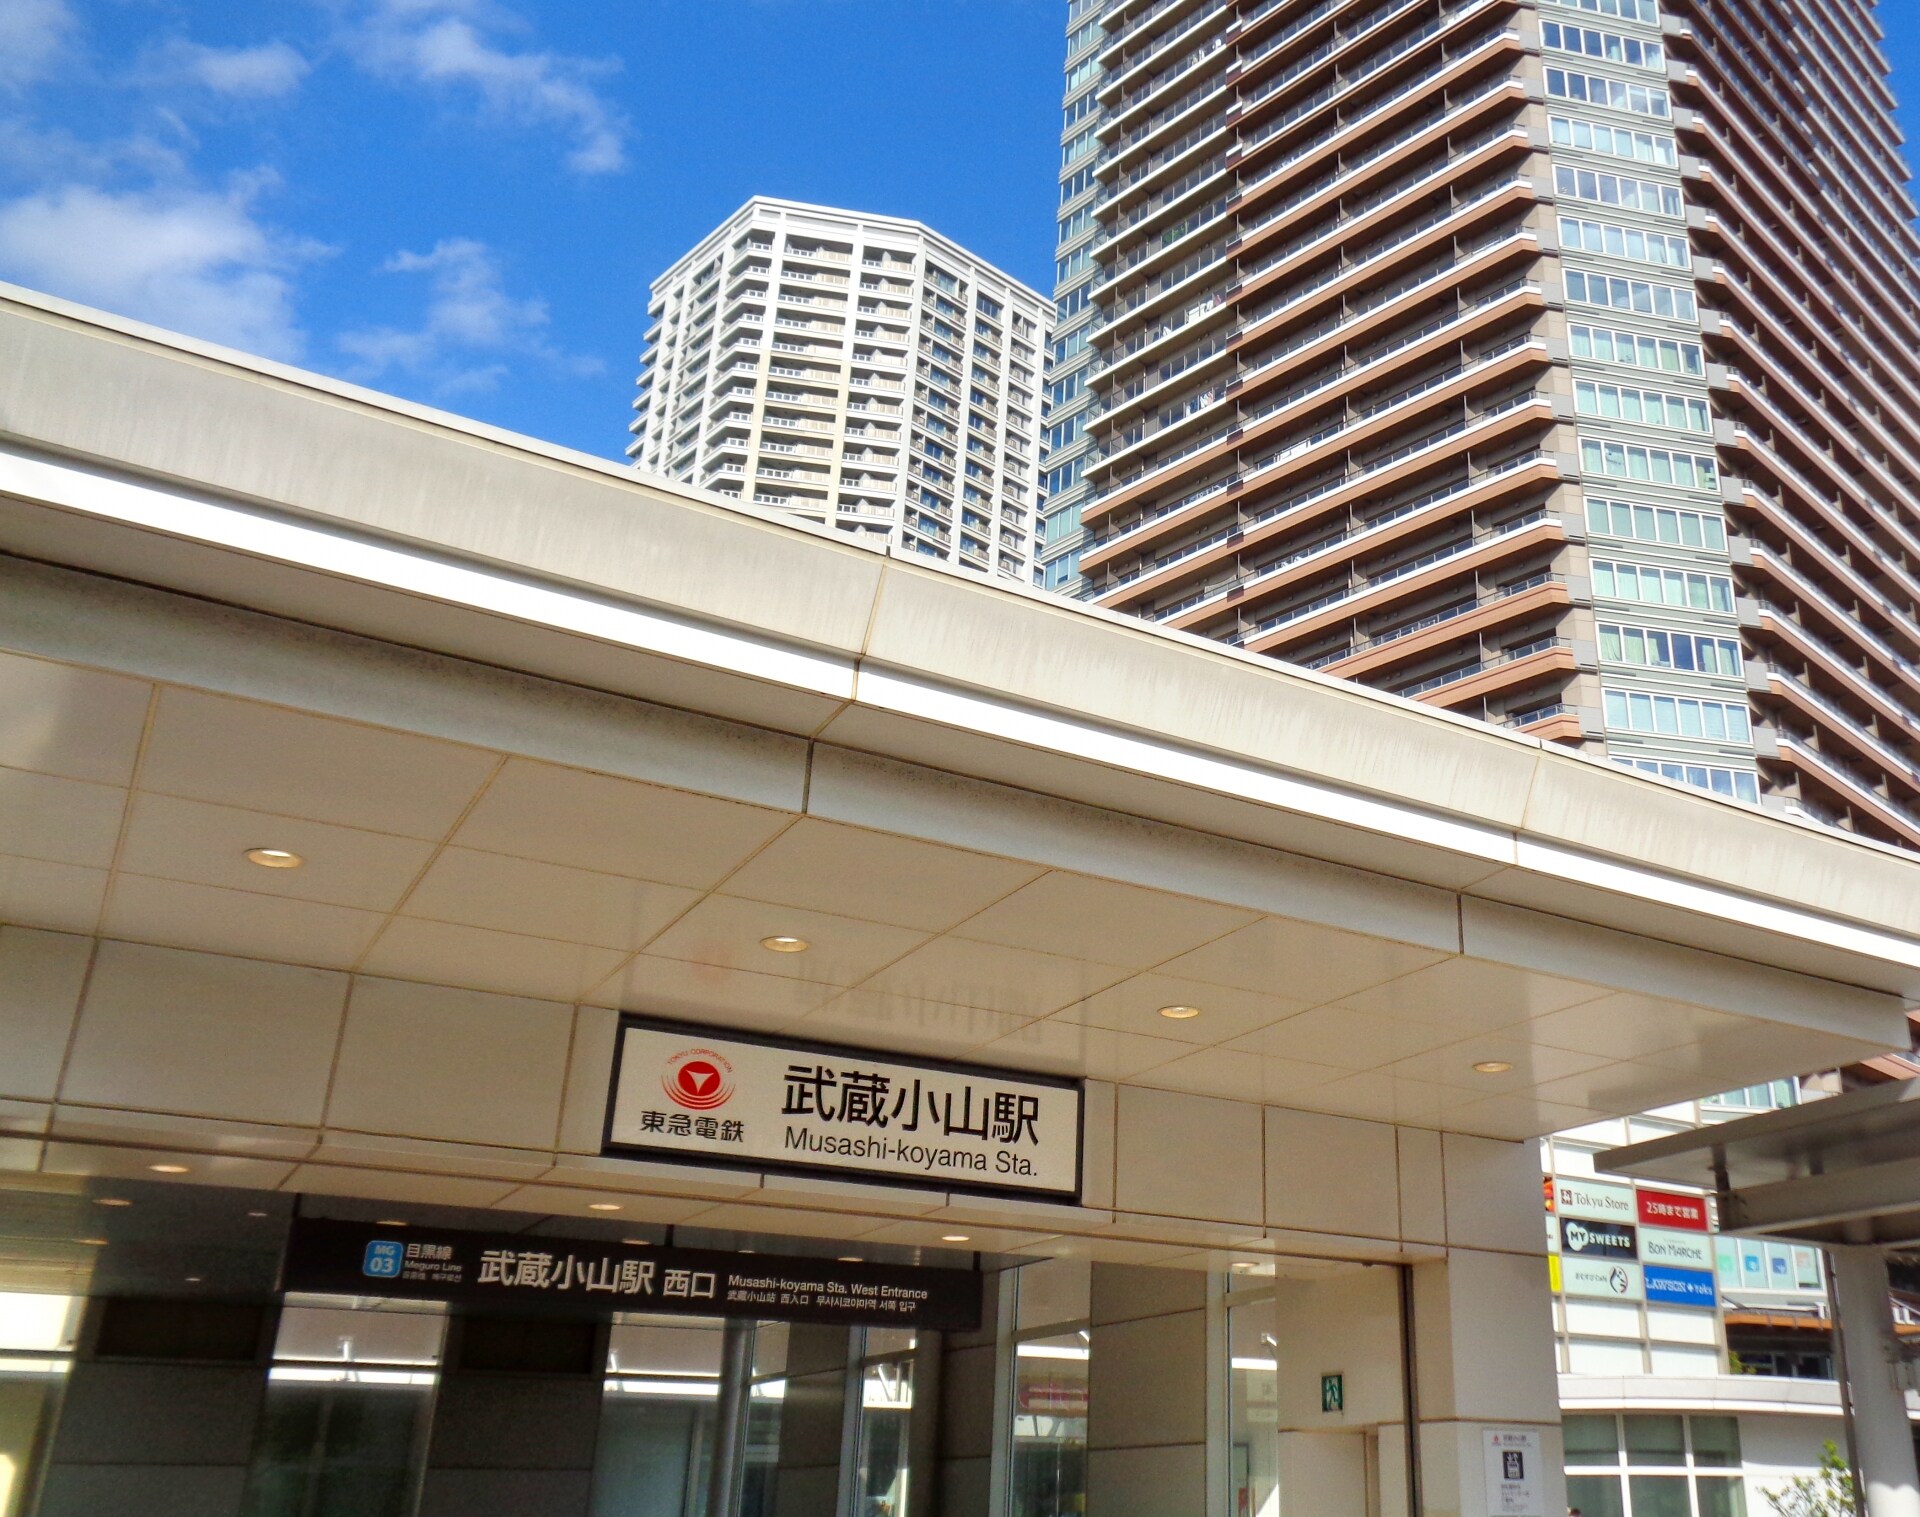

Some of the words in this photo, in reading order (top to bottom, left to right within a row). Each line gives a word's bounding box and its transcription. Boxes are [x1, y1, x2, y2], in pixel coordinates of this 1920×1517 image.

[667, 1050, 689, 1065] TOKYU
[690, 1048, 733, 1073] CORPORATION
[781, 1065, 1039, 1146] 武蔵小山駅
[640, 1110, 745, 1143] 東急電鉄
[784, 1126, 987, 1172] Musashi-koyama
[995, 1151, 1038, 1176] Sta.
[1574, 1192, 1604, 1209] Tokyu
[1605, 1196, 1629, 1211] Store
[1570, 1231, 1586, 1242] MY
[1589, 1232, 1631, 1248] SWEETS
[374, 1245, 395, 1256] MG
[406, 1243, 453, 1260] 目黒線
[370, 1257, 394, 1273] 03
[404, 1260, 440, 1272] Meguro
[442, 1262, 462, 1272] Line
[477, 1250, 655, 1295] 武蔵小山駅
[662, 1268, 716, 1299] 西口
[728, 1275, 824, 1292] Musashi-koyama
[826, 1281, 847, 1294] Sta.
[851, 1284, 878, 1296] West
[880, 1286, 928, 1299] Entrance
[1645, 1277, 1687, 1293] LAWSON
[780, 1293, 809, 1305] 西入口
[815, 1294, 877, 1309] 무사시코야마역
[898, 1300, 917, 1313] 입구
